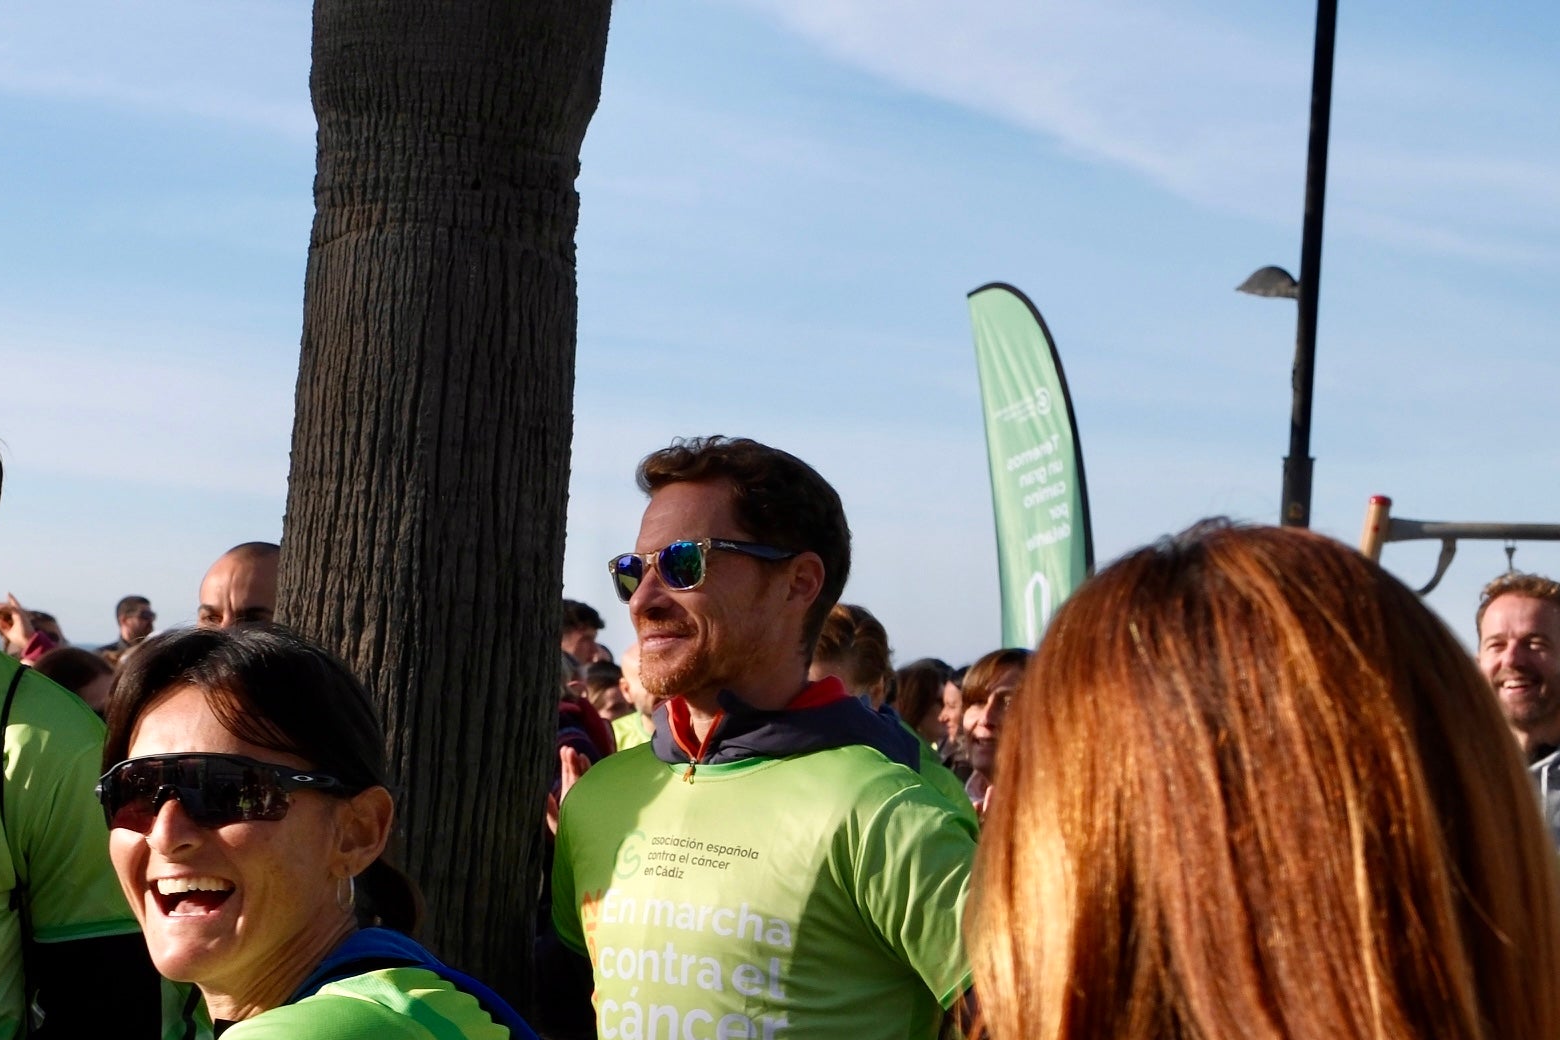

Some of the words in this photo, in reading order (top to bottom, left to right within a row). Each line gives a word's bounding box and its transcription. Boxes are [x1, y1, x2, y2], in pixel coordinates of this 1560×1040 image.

[651, 836, 704, 851] asociación
[706, 842, 759, 860] española
[644, 866, 654, 876] en
[655, 865, 684, 880] Cádiz
[648, 851, 676, 862] contra
[679, 853, 689, 864] el
[691, 854, 731, 871] cáncer
[602, 888, 635, 925] En
[642, 898, 793, 948] marcha
[599, 942, 724, 991] contra
[731, 957, 785, 1000] el
